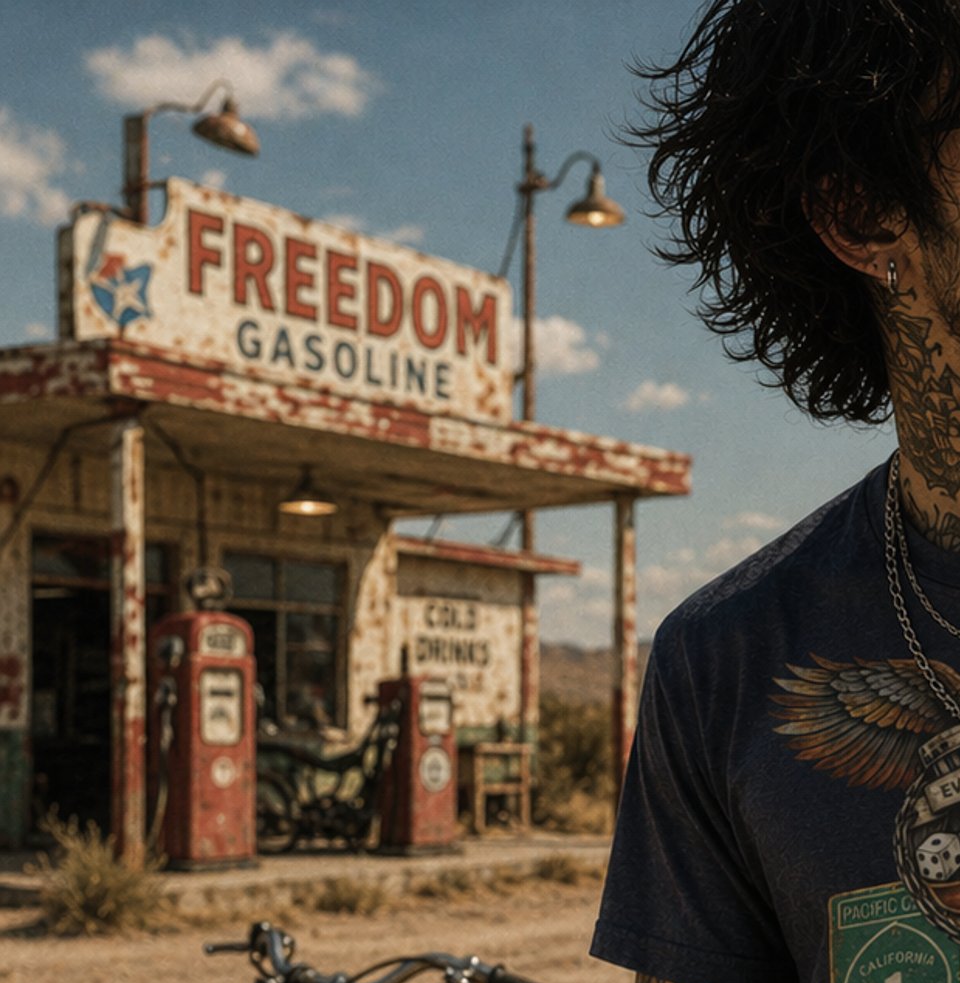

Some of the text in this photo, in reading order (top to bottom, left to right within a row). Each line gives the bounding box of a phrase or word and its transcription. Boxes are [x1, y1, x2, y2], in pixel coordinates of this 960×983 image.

[187, 207, 498, 366] FREEDOM
[236, 320, 454, 400] GASOLINE
[423, 603, 477, 630] COLD
[416, 635, 489, 667] DRINKS
[842, 897, 898, 922] PACIFIC
[859, 950, 935, 977] CALIFORNIA
